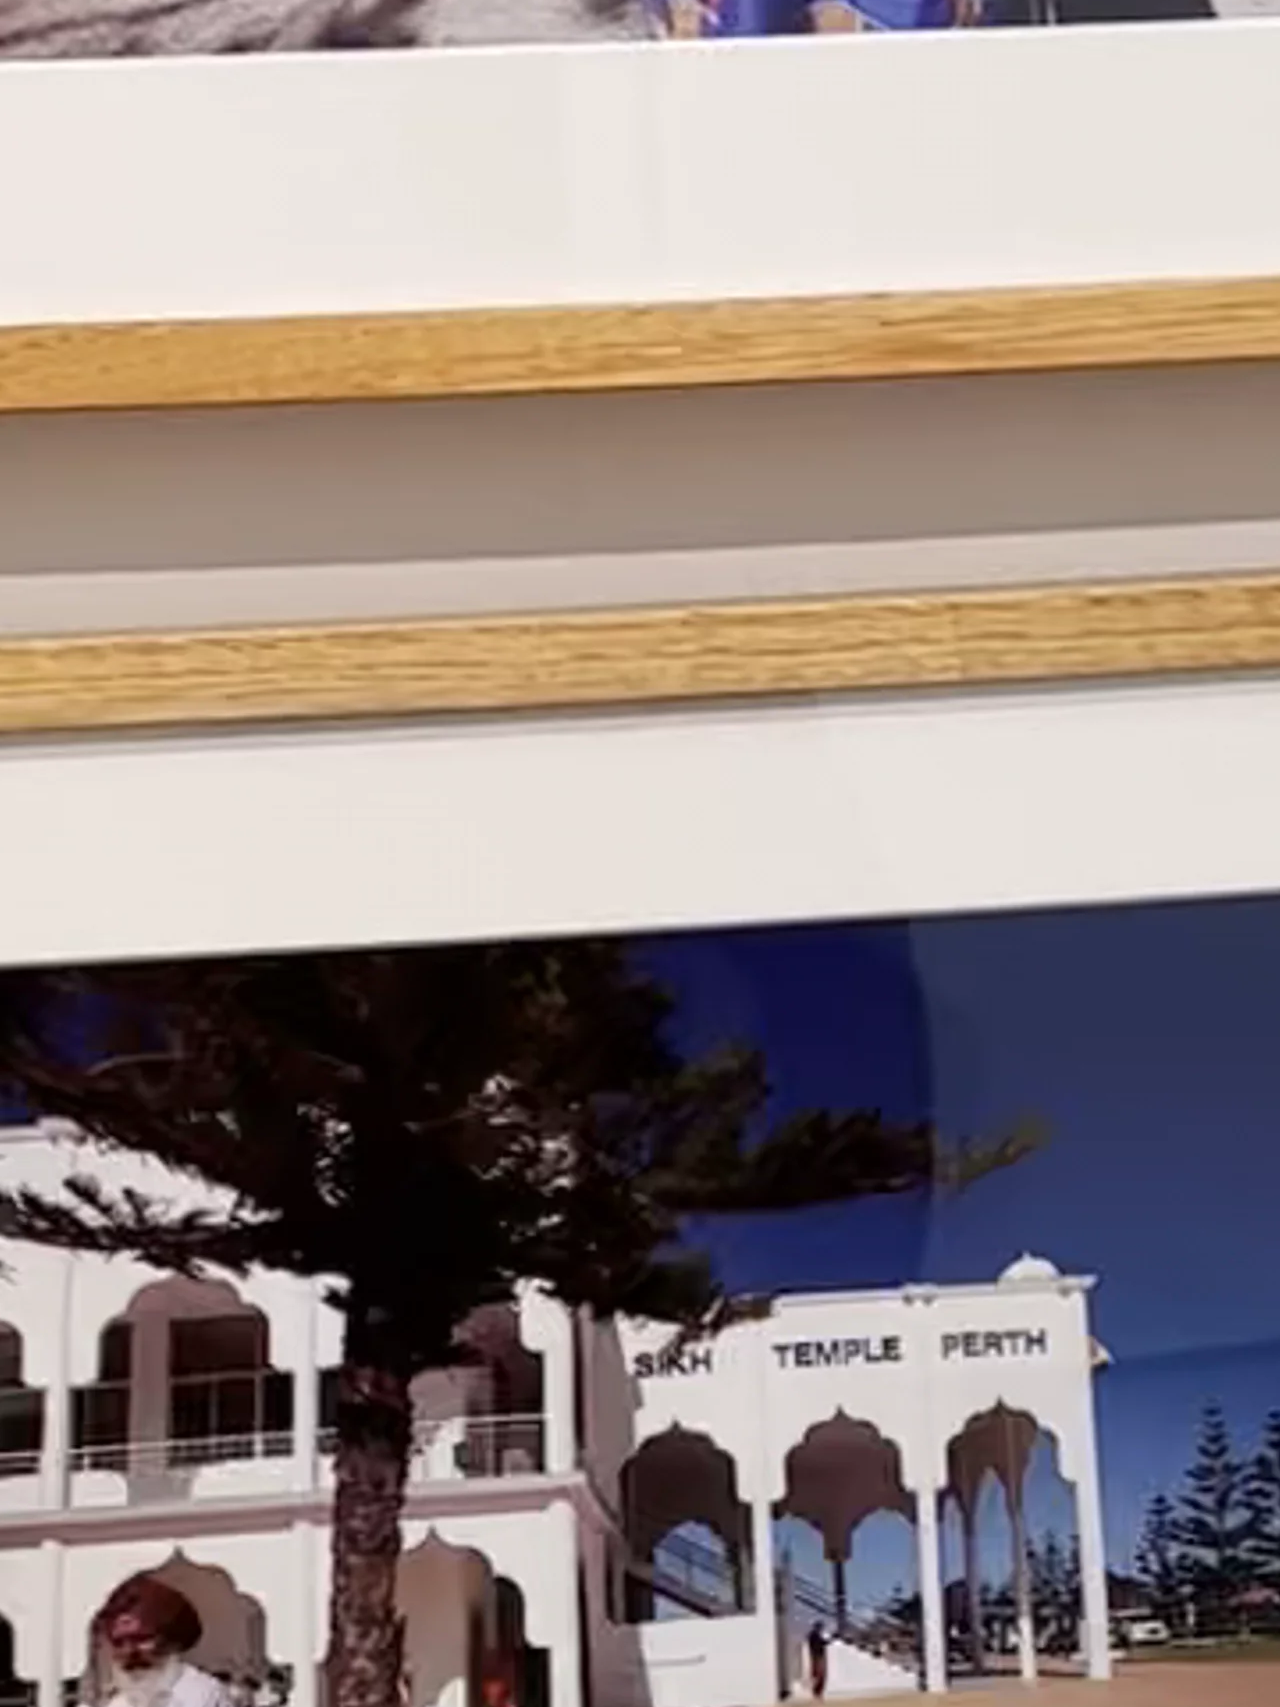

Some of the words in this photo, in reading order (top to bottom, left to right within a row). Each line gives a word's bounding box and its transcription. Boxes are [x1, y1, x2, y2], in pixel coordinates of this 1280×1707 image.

[634, 1347, 712, 1379] SIKH
[772, 1336, 903, 1369] TEMPLE
[941, 1329, 1047, 1359] PERTH
